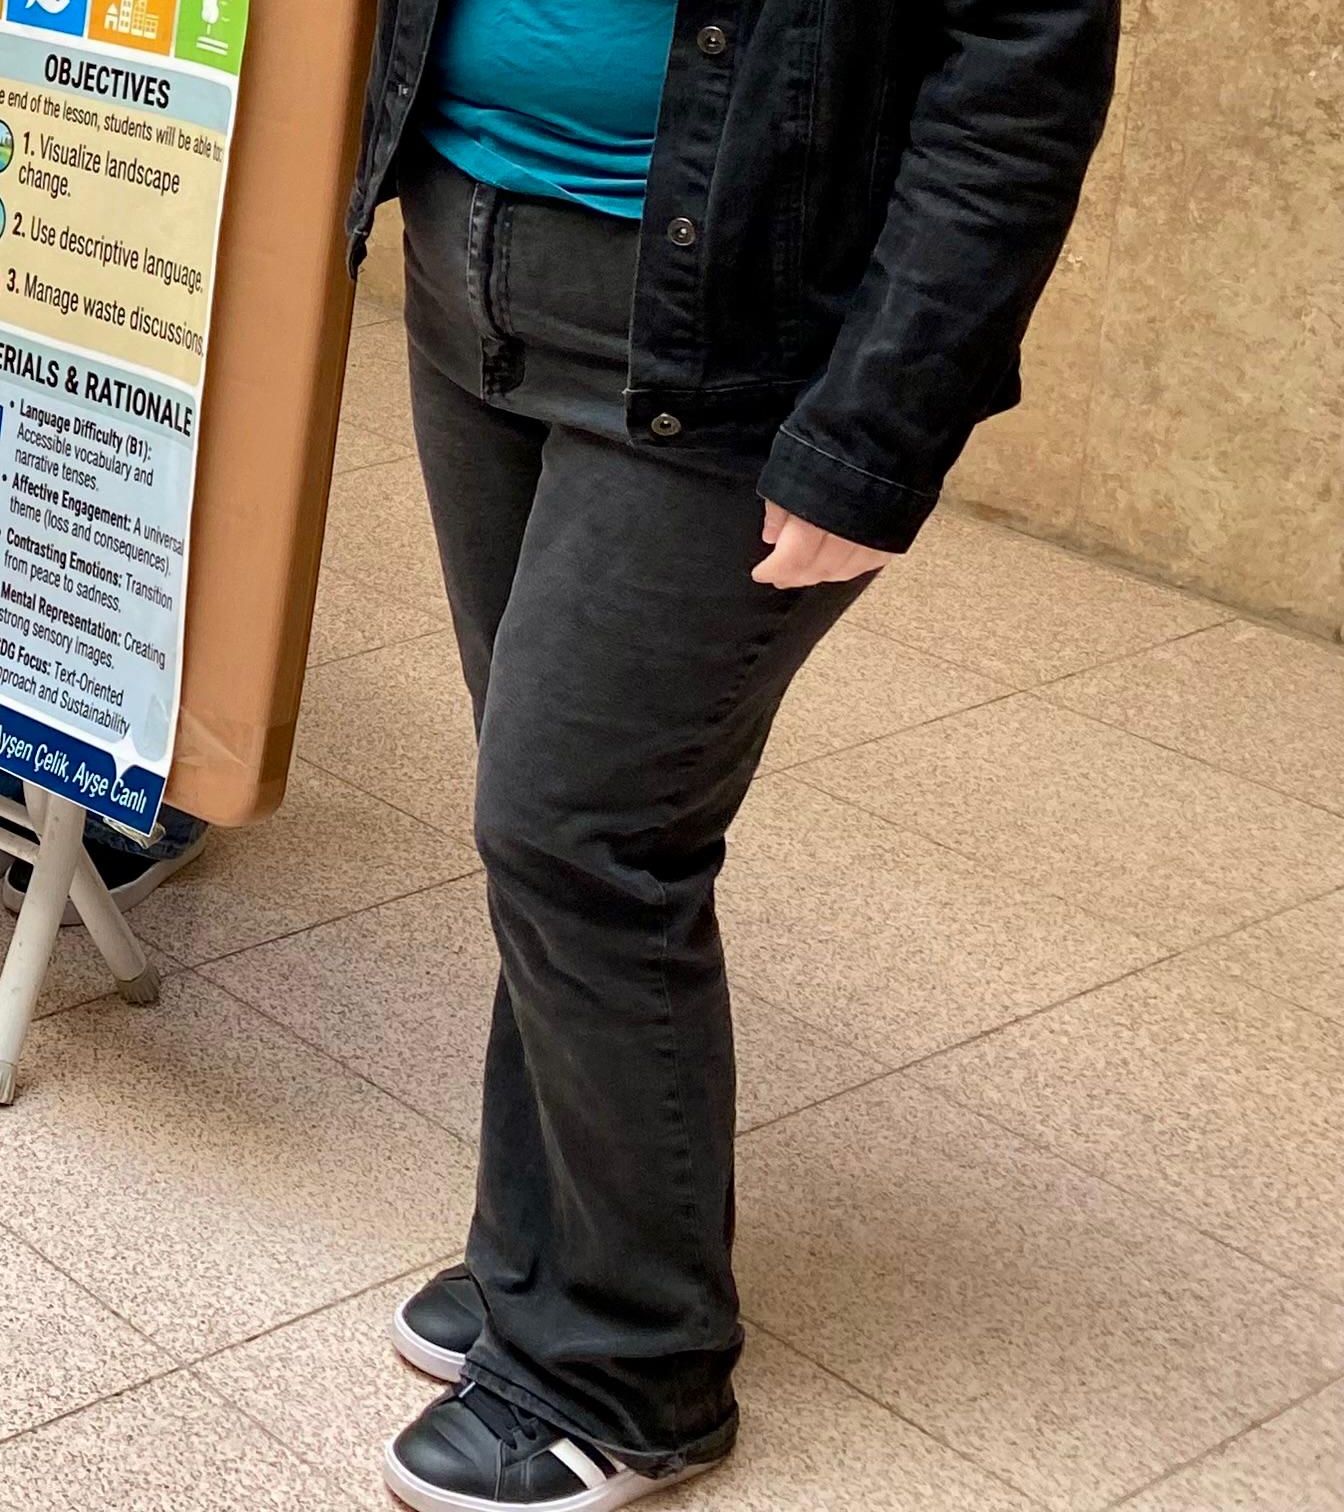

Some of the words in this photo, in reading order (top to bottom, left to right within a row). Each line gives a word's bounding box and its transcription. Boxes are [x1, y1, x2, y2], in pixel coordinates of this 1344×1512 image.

[44, 53, 170, 108] OBJECTIVES
[7, 91, 28, 110] end
[29, 94, 42, 113] of
[43, 97, 60, 118] the
[62, 100, 100, 131] lesson,
[103, 113, 152, 141] students
[156, 126, 175, 145] will
[177, 128, 191, 151] be
[192, 135, 211, 158] able
[18, 161, 70, 199] change.
[23, 131, 34, 156] 1.
[40, 133, 101, 173] Visualize
[104, 150, 179, 196] landscape
[11, 211, 25, 237] 2.
[30, 215, 56, 246] Use
[59, 226, 138, 269] descriptive
[142, 247, 203, 294] language.
[6, 267, 19, 293] 3.
[23, 272, 78, 315] Manage
[83, 296, 125, 326] waste
[129, 306, 204, 357] discussions.
[19, 398, 70, 434] Language
[72, 416, 123, 454] Difficulty
[125, 434, 153, 462] (B1):
[64, 365, 78, 395] &
[84, 371, 192, 436] RATIONALE
[16, 421, 71, 457] Accessible
[74, 445, 132, 481] vocabulary
[133, 466, 153, 486] and
[11, 472, 59, 505] Affective
[61, 489, 131, 531] Engagement:
[6, 527, 66, 569] Contrasting
[68, 550, 122, 587] Emotions:
[125, 572, 172, 609] Transition
[0, 580, 36, 610] Mental
[38, 596, 121, 646] Representation:
[123, 631, 165, 670] Creating
[16, 645, 51, 675] Focus:
[54, 660, 123, 706] Text-Oriented
[34, 743, 69, 782] Çelik,
[72, 761, 108, 797] Ayşe
[110, 774, 146, 813] Canlı
